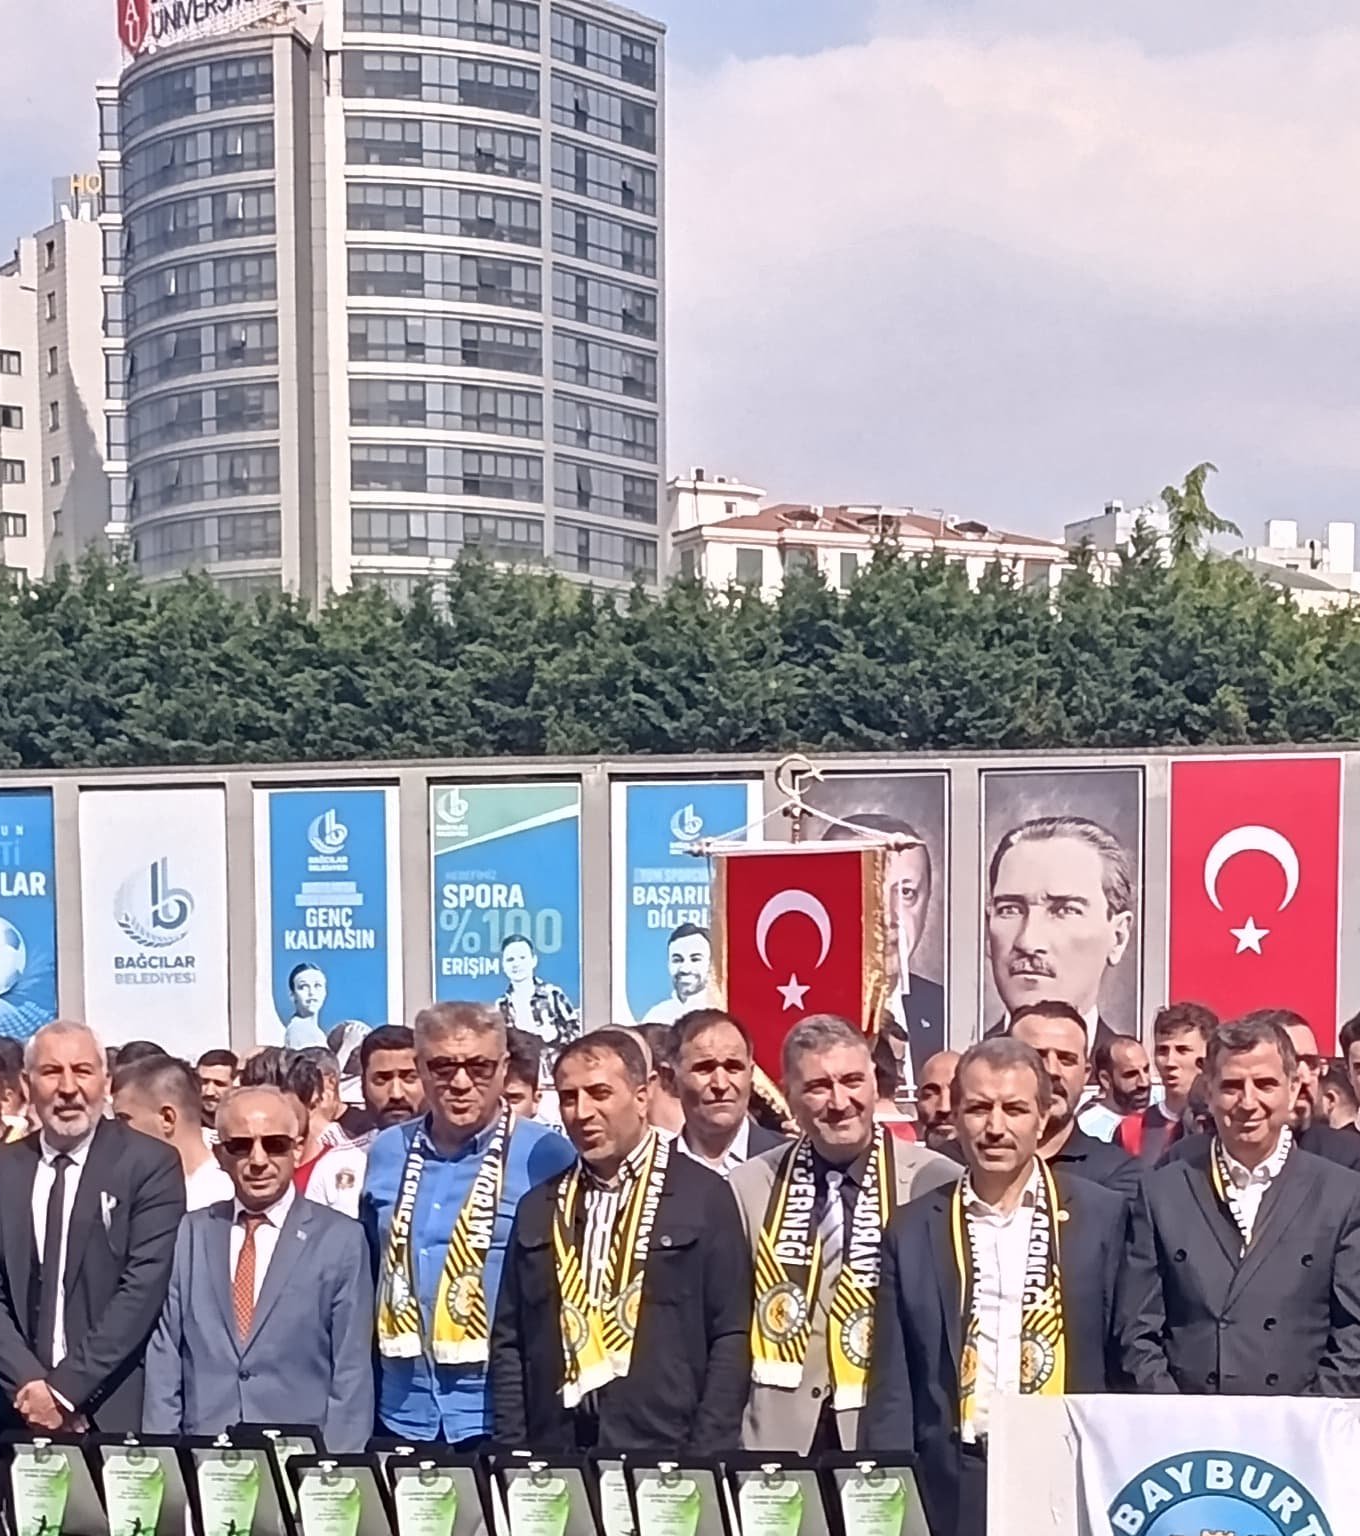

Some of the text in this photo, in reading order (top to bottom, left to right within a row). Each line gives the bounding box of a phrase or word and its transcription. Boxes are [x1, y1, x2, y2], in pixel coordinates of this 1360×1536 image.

[70, 173, 103, 195] HO
[442, 883, 525, 909] SPORA
[632, 885, 710, 909] BAŞARIL
[305, 907, 353, 929] GENÇ
[647, 907, 710, 929] DİLERİ
[284, 929, 375, 950] KALMASIN
[440, 908, 563, 954] %100
[113, 952, 196, 969] BAĞCILAR
[442, 956, 500, 979] ERİŞİM
[114, 971, 196, 985] BELEDİYESİ
